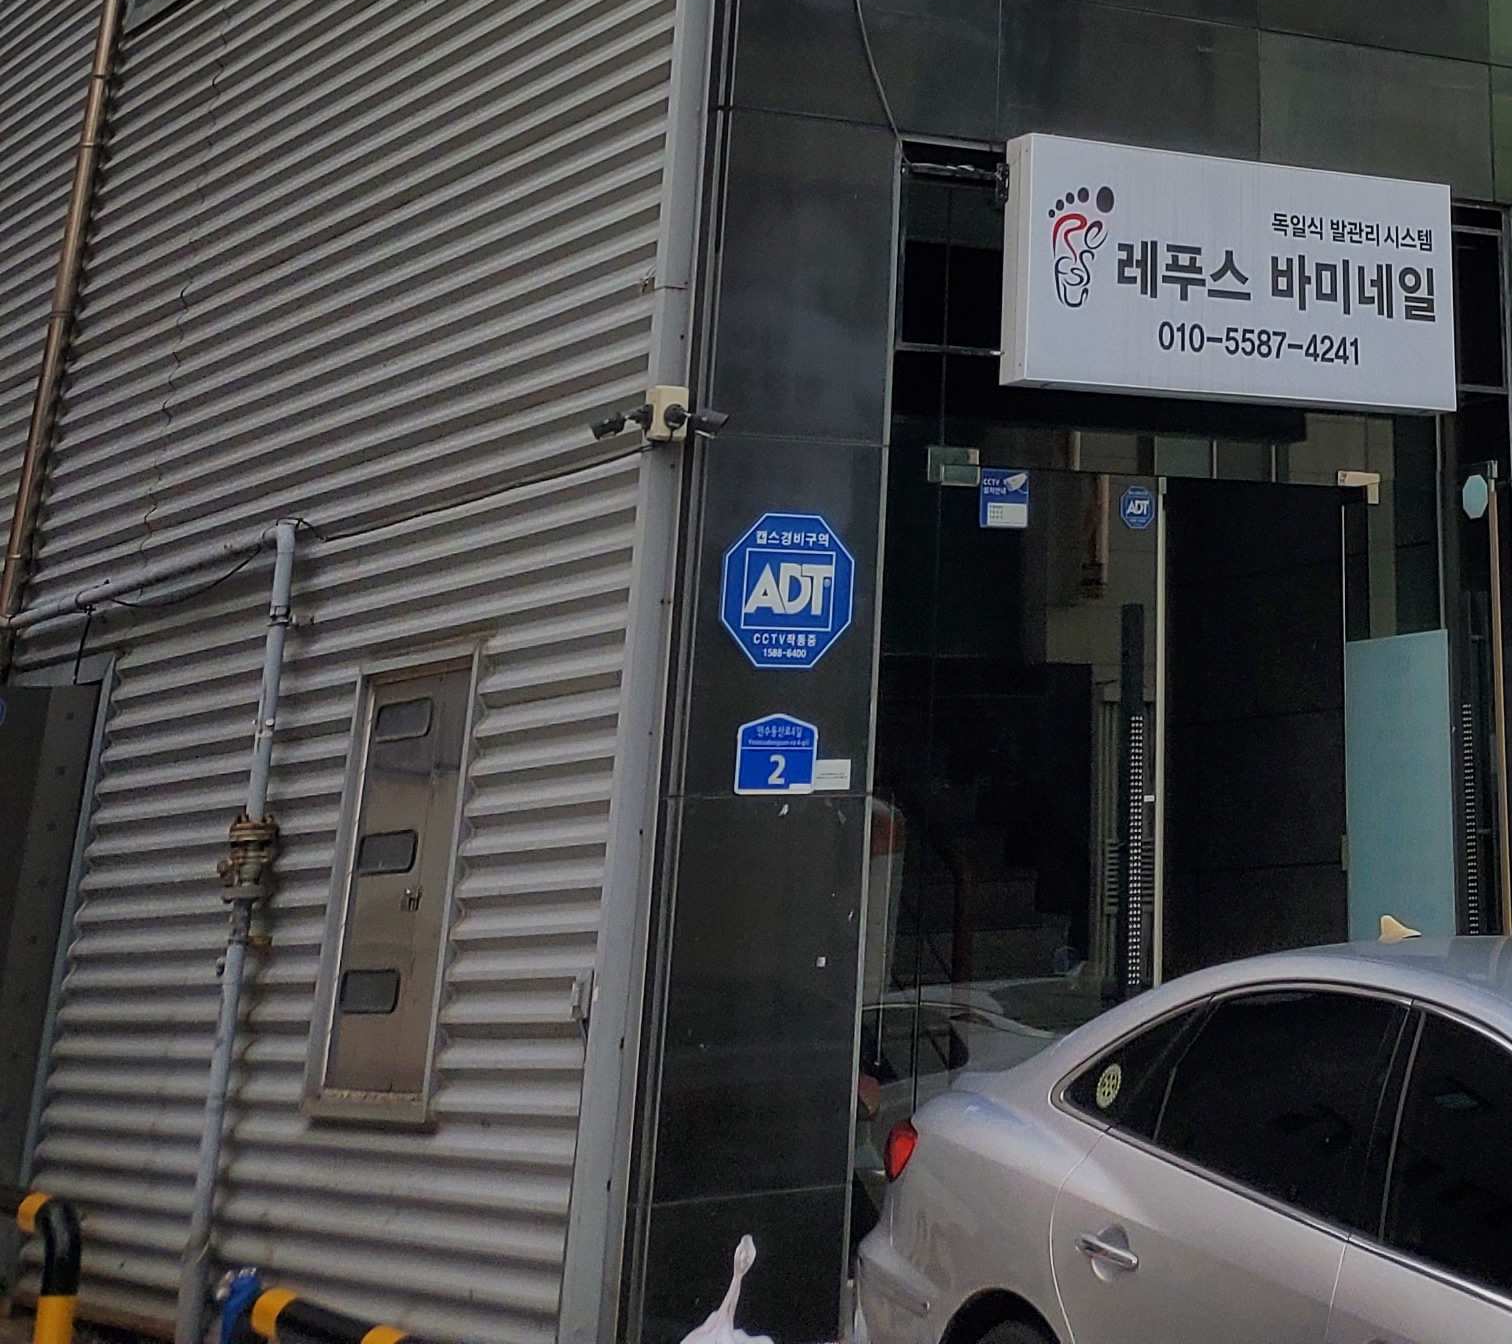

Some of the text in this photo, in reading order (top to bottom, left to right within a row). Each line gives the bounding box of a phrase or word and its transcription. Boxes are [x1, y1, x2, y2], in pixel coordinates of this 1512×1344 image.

[1272, 212, 1434, 253] 독일식 발관리 시스템
[1117, 239, 1437, 323] 레푸스 바미네일
[1158, 320, 1361, 366] 010-5587-4241
[1126, 500, 1150, 515] ADT
[744, 562, 833, 615] ADT
[768, 754, 786, 785] 2
